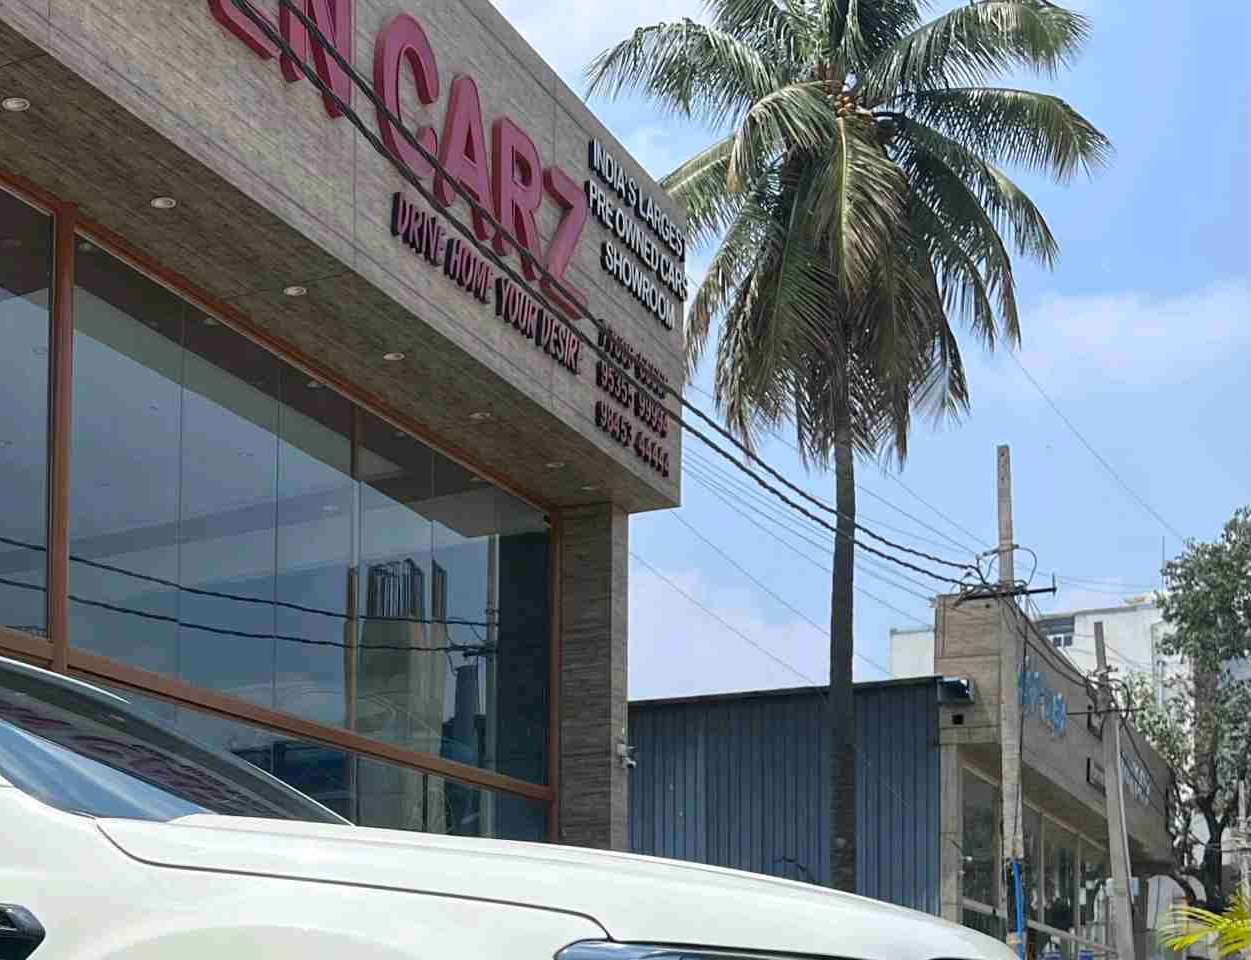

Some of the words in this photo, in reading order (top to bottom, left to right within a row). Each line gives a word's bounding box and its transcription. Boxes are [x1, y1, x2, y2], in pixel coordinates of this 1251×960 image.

[373, 14, 590, 320] CARZ
[590, 137, 637, 207] INDIA'S
[391, 192, 445, 266] DRIVE
[445, 238, 494, 304] HOME
[496, 276, 537, 339] YOUR
[536, 308, 584, 375] DESIRE
[586, 179, 614, 229] PRE
[614, 206, 660, 270] OWNED
[659, 253, 688, 301] CARS
[602, 239, 675, 330] SHOWROOM
